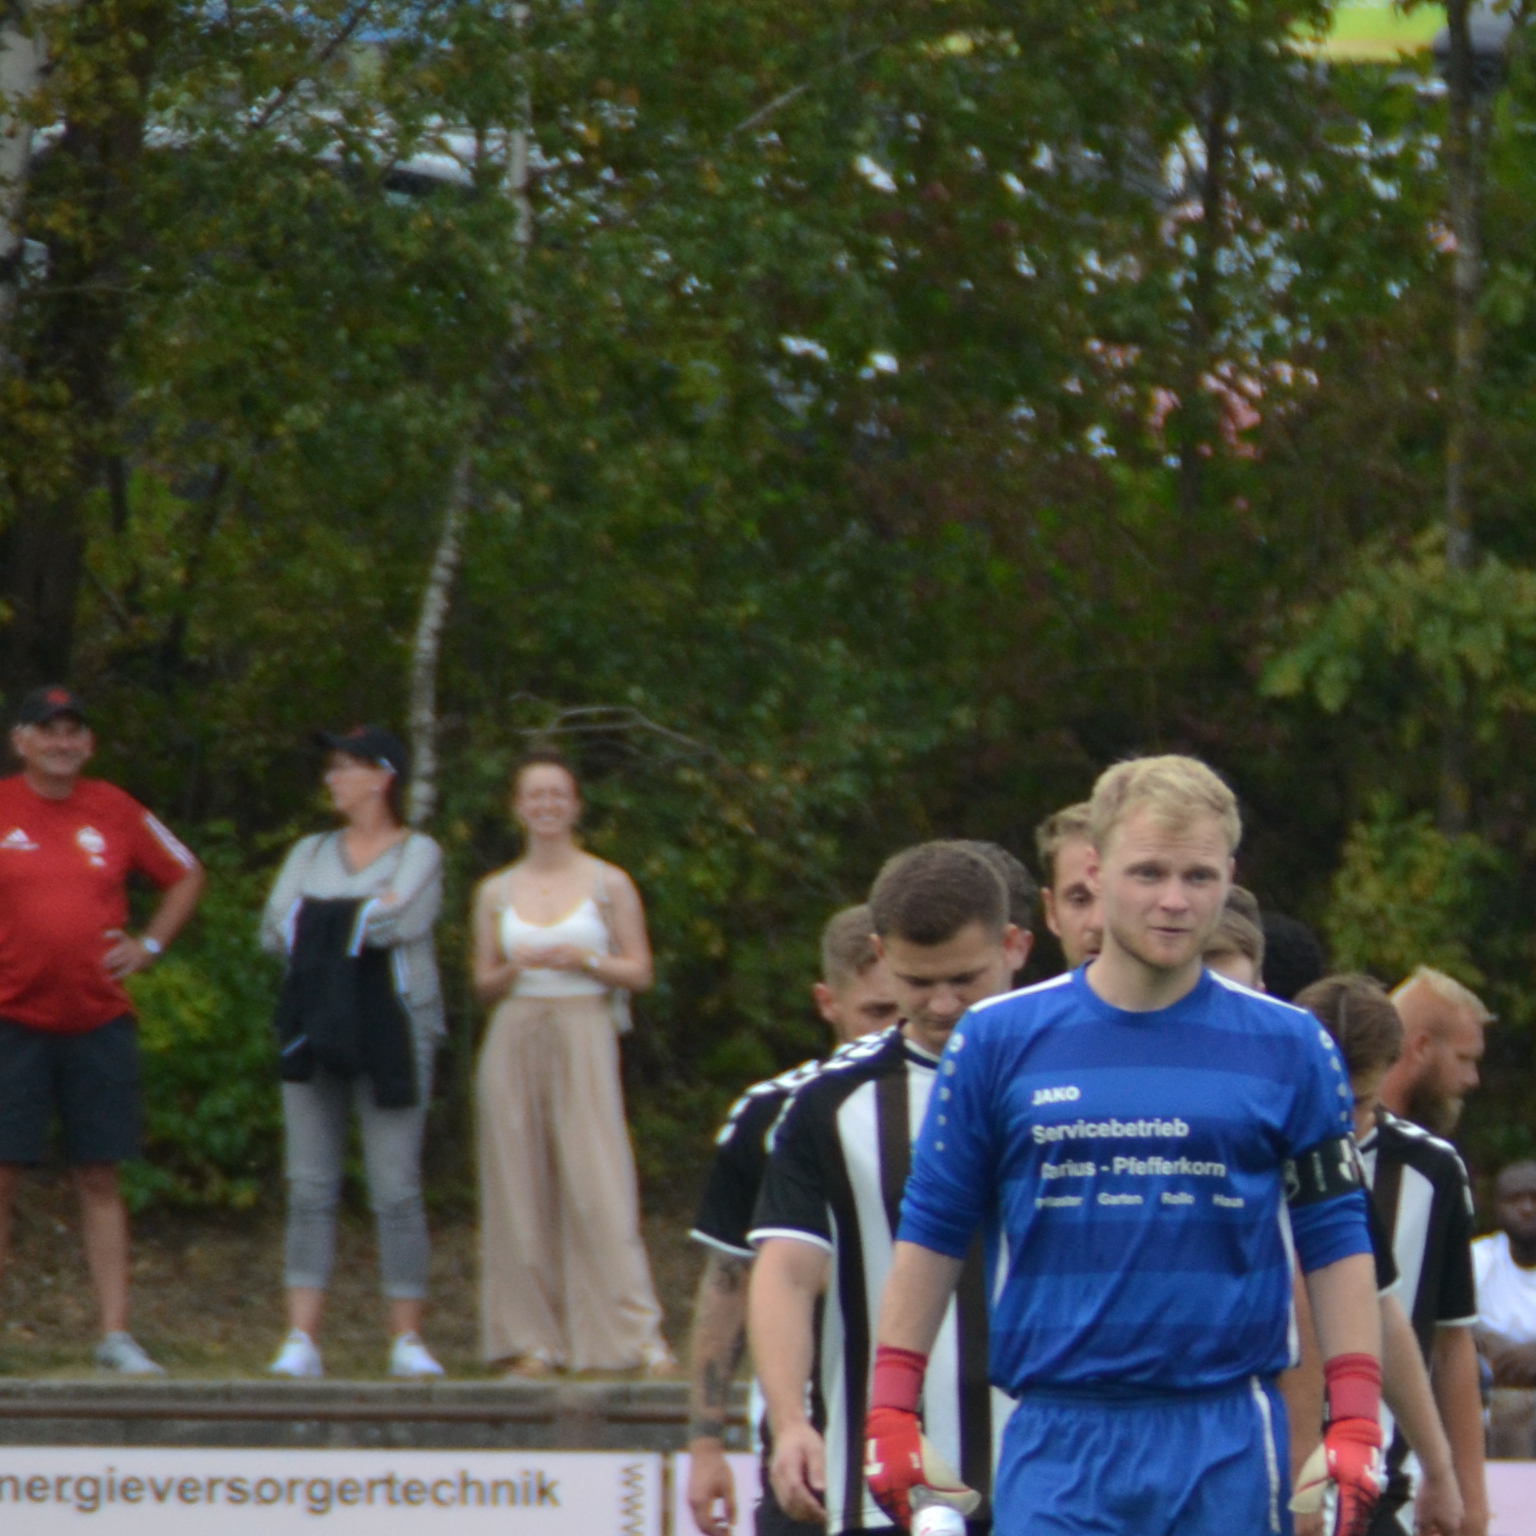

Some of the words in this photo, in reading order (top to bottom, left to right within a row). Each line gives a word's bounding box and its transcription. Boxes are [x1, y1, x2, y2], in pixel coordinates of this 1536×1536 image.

[1032, 1085, 1081, 1106] JAKO
[1032, 1118, 1189, 1145] Servicebetrieb
[1113, 1156, 1226, 1178] Pfefferkorn
